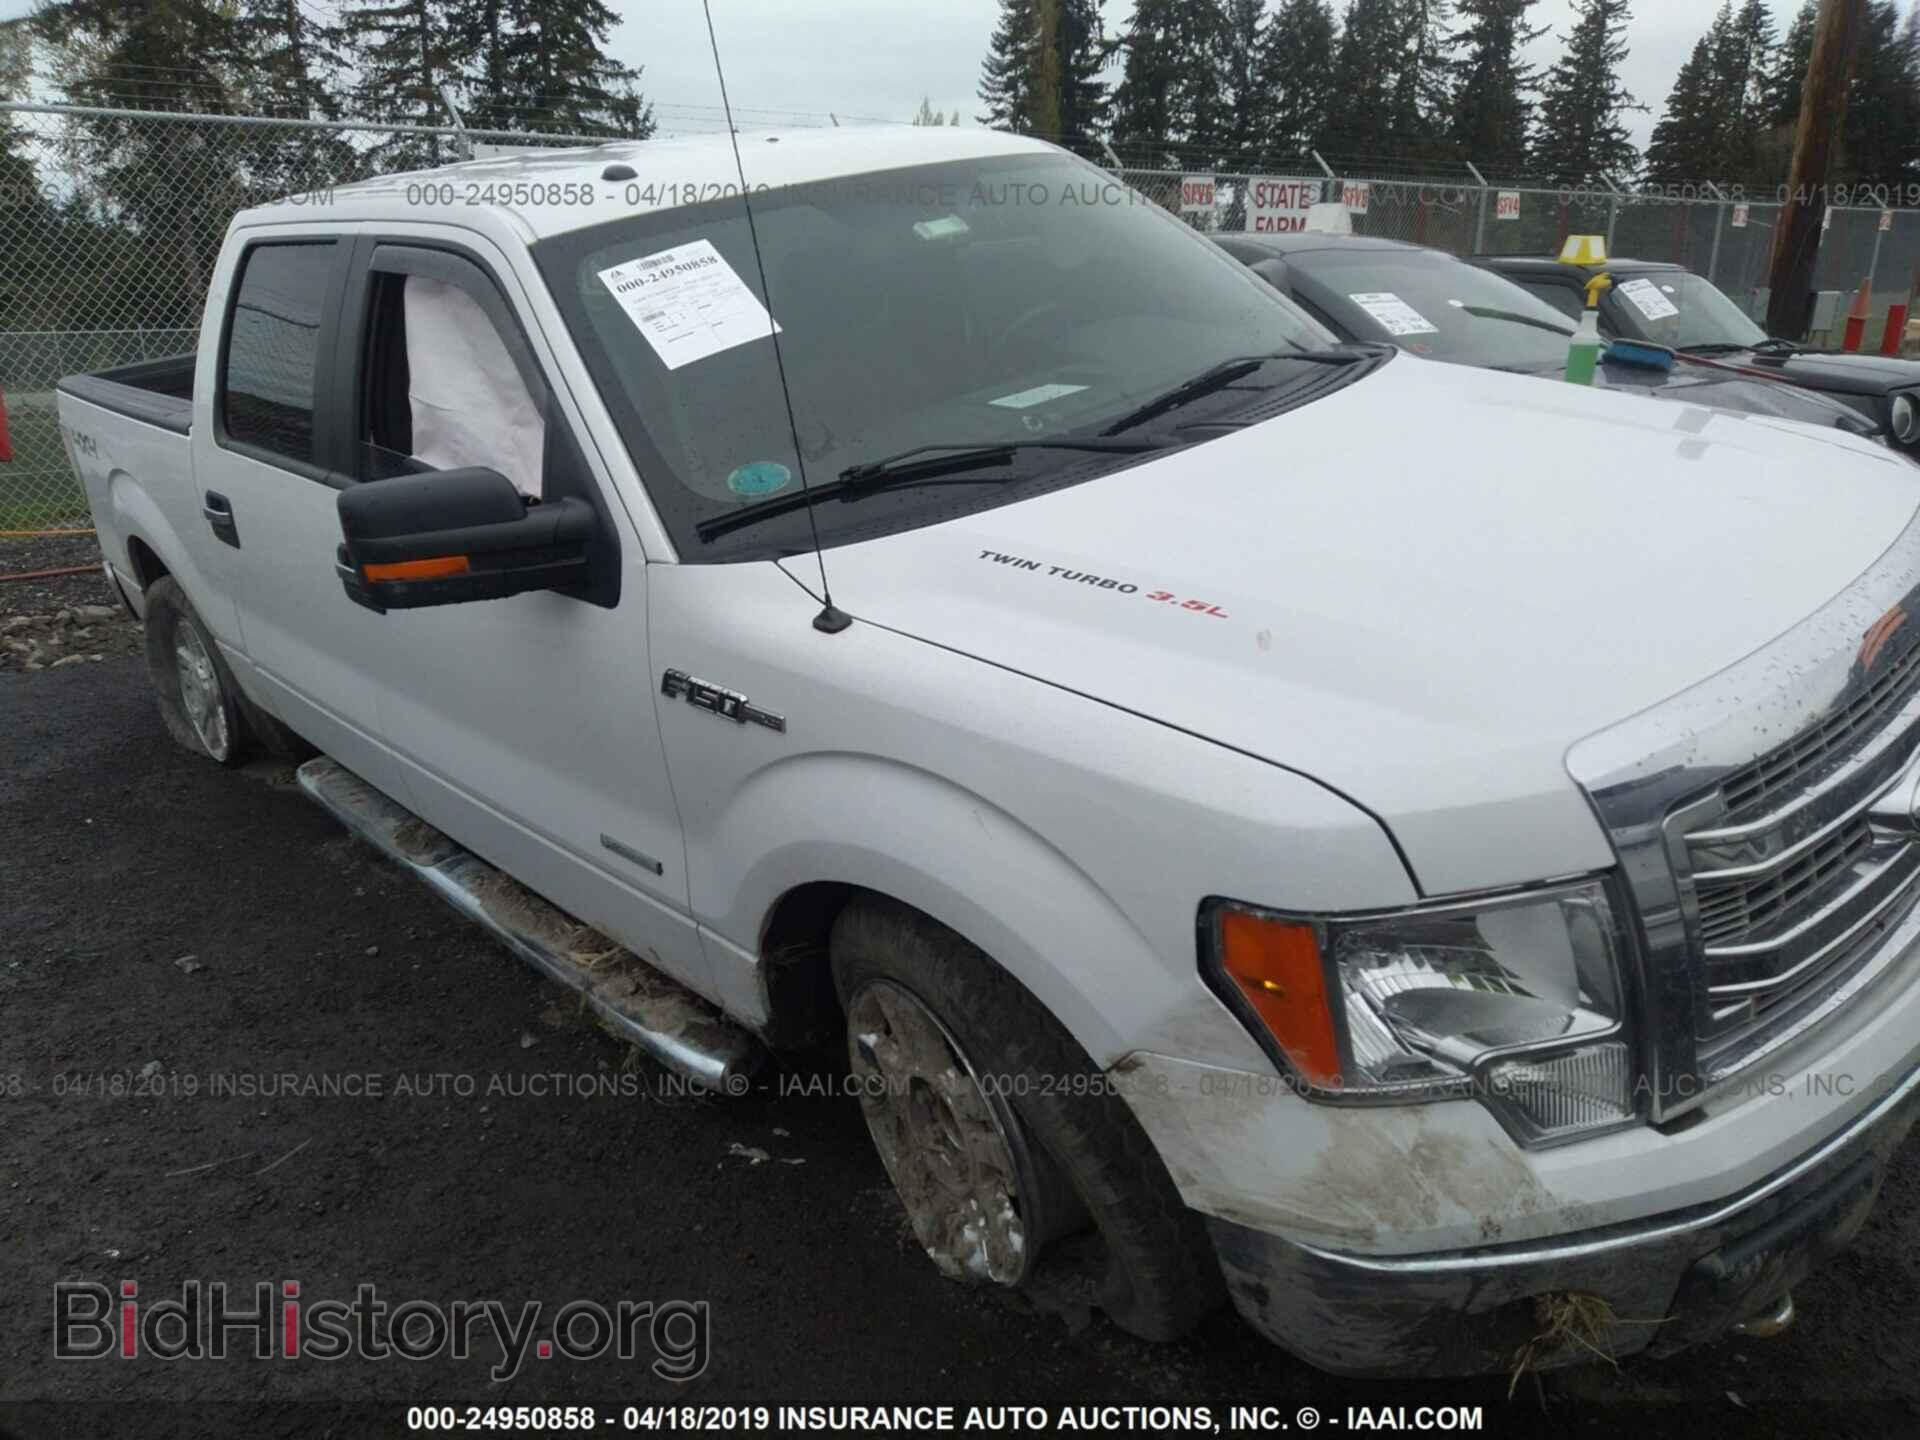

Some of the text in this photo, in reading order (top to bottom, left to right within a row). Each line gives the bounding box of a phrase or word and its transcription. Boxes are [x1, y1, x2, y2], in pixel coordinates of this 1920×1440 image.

[1256, 182, 1310, 209] STATE
[616, 254, 719, 294] 000-24950858
[978, 550, 1229, 619] TWIN TURBO 3.5L
